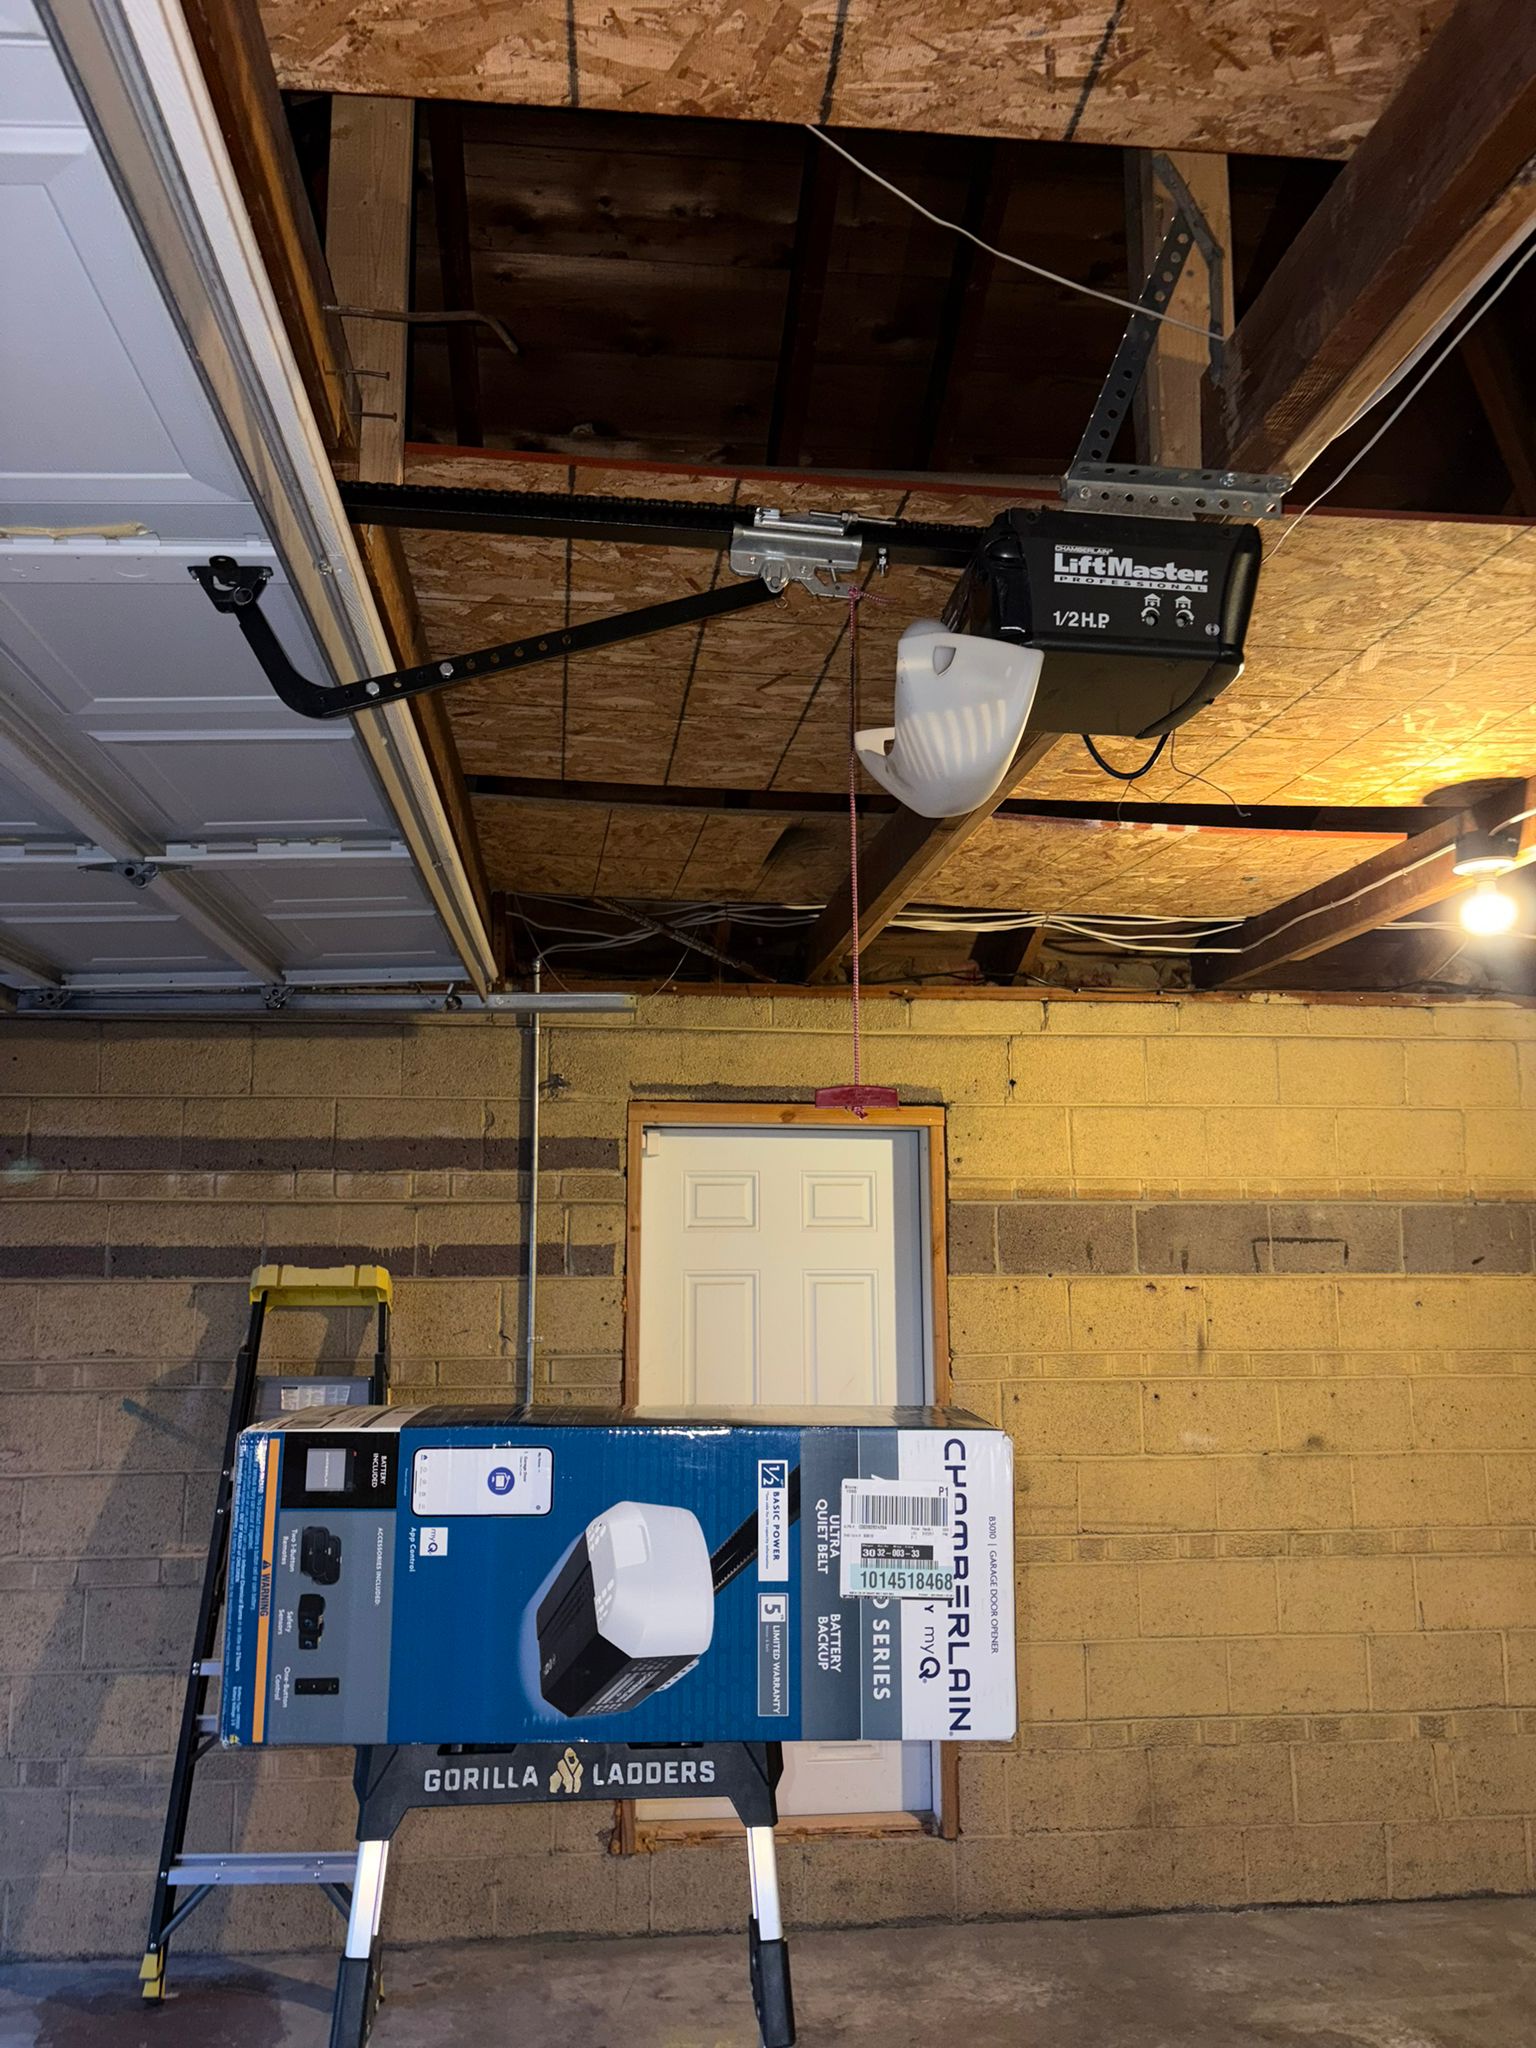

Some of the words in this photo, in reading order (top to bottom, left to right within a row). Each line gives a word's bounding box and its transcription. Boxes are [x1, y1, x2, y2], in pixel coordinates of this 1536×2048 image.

[1055, 545, 1110, 555] CHAMBERLAIN
[1060, 576, 1206, 592] PROFESSIONAL
[1053, 611, 1079, 626] 1/2
[939, 1486, 948, 1496] P1
[408, 1527, 416, 1542] App
[816, 1498, 828, 1540] QUIET
[281, 1536, 289, 1566] Remotes
[830, 1514, 840, 1558] ULTRA
[817, 1544, 828, 1574] BELT
[862, 1548, 876, 1558] 30
[990, 1550, 998, 1587] GARAGE
[260, 1573, 270, 1616] WARNING
[860, 1571, 953, 1591] 1014518468
[764, 1604, 781, 1614] 5
[990, 1589, 998, 1617] DOOR
[285, 1610, 294, 1632] Safety
[990, 1618, 999, 1654] OPENER
[772, 1625, 780, 1660] LIMITED
[818, 1616, 828, 1670] BACKUP
[830, 1614, 842, 1672] BATTERY
[918, 1626, 941, 1680] myQ
[872, 1618, 891, 1700] SERIES
[282, 1666, 291, 1708] One-Button
[772, 1661, 780, 1714] WARRANTY
[424, 1766, 539, 1792] GORILLA
[593, 1760, 716, 1786] LADDERS
